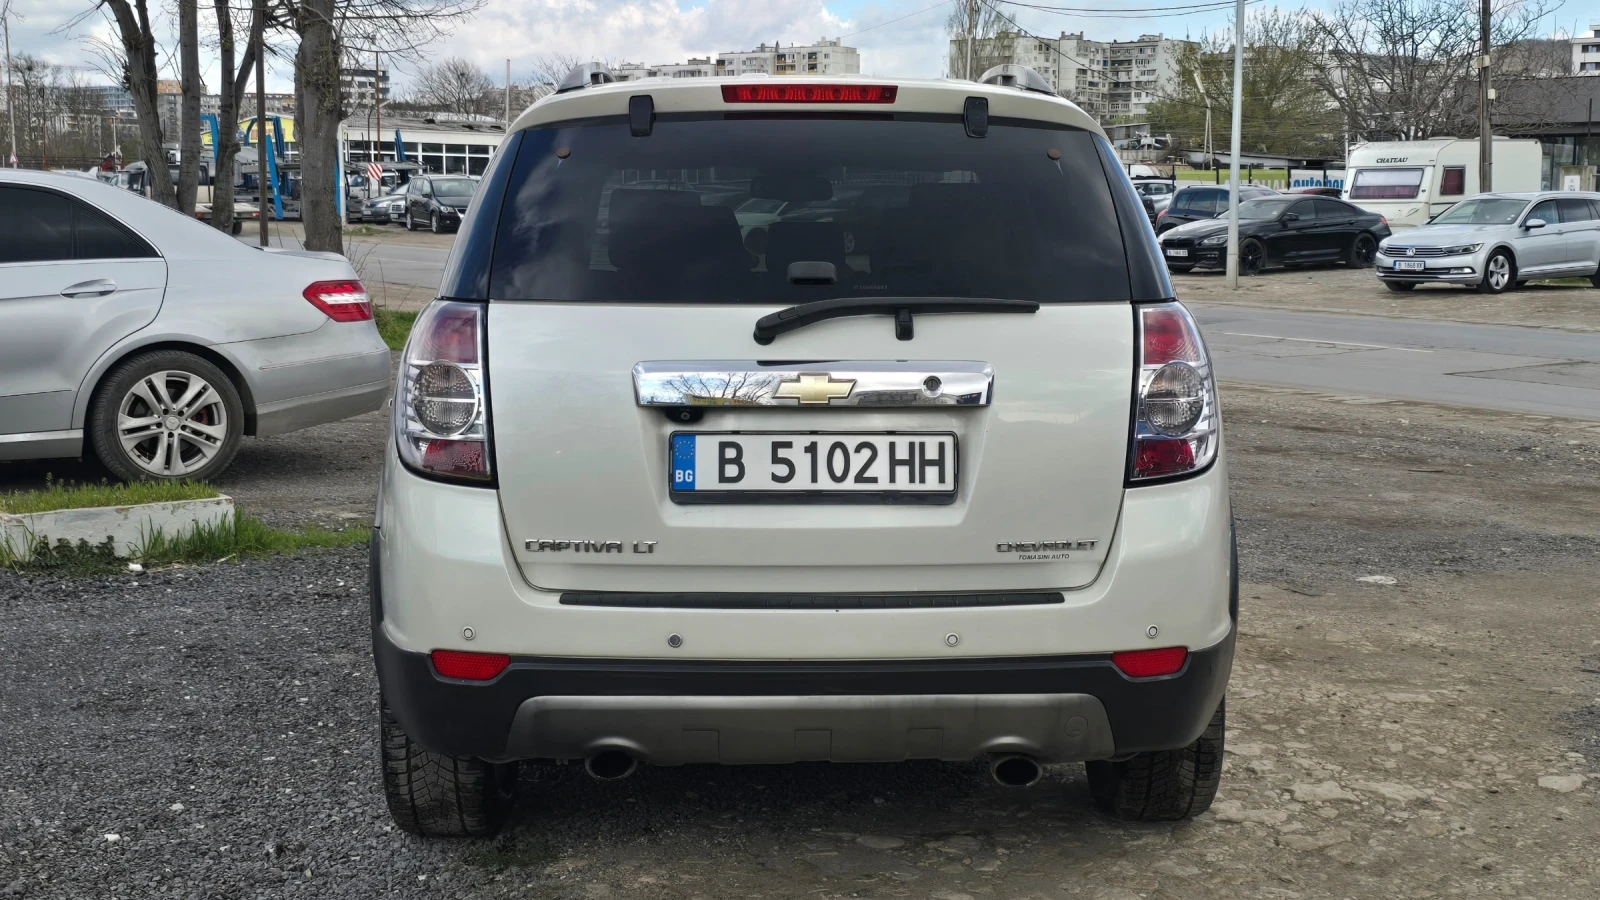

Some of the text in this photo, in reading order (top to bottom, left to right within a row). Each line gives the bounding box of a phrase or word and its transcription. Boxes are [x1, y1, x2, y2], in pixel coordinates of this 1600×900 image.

[718, 441, 746, 484] B
[675, 469, 694, 483] BG
[525, 539, 658, 553] CAPTIVA LT
[997, 539, 1098, 553] CHEVROLET
